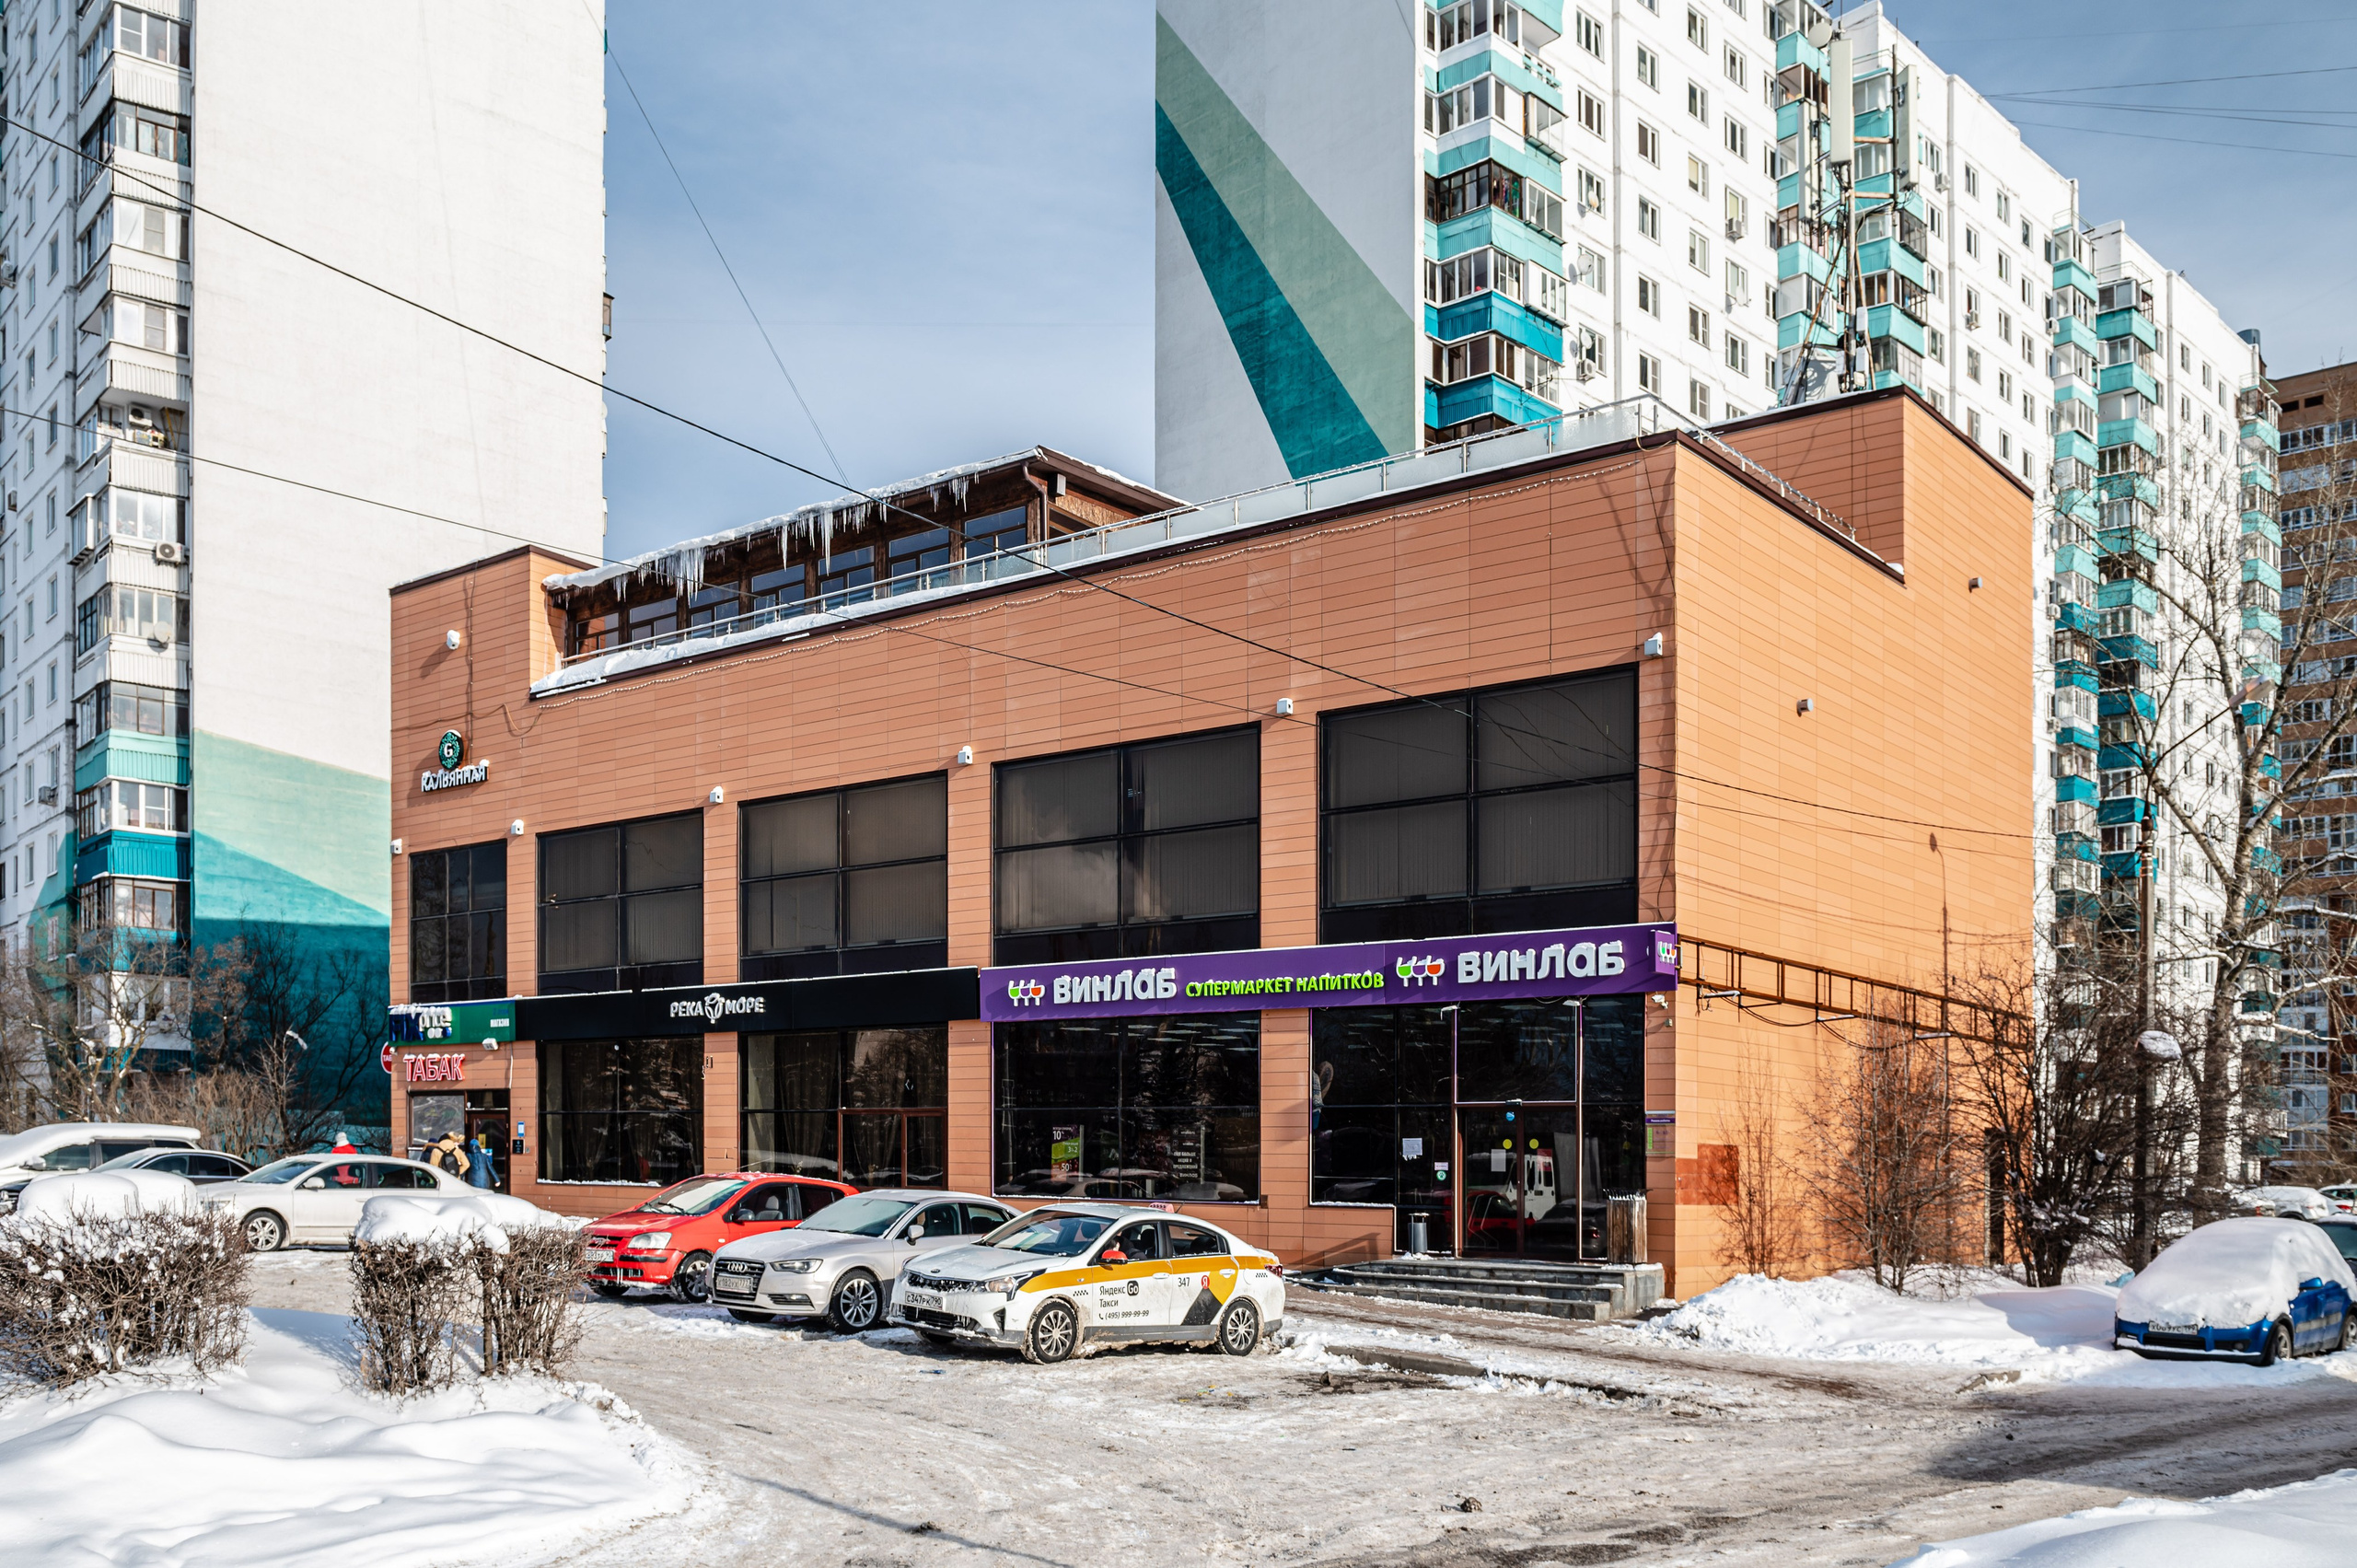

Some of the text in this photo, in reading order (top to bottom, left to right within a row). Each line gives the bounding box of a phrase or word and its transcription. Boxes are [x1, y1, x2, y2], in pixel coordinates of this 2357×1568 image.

[444, 743, 453, 758] G
[1053, 941, 1625, 1004] ВИНЛАБ СУПЕРМАРКЕТ НАПИТКОВ ВИНЛАБ
[670, 997, 765, 1017] РЕКА МОРЕ
[403, 1054, 466, 1081] ТАБАК
[1178, 1277, 1190, 1287] 347
[1099, 1283, 1139, 1295] Яндекс Go
[1099, 1299, 1119, 1307] Такси
[1105, 1311, 1120, 1319] (495)
